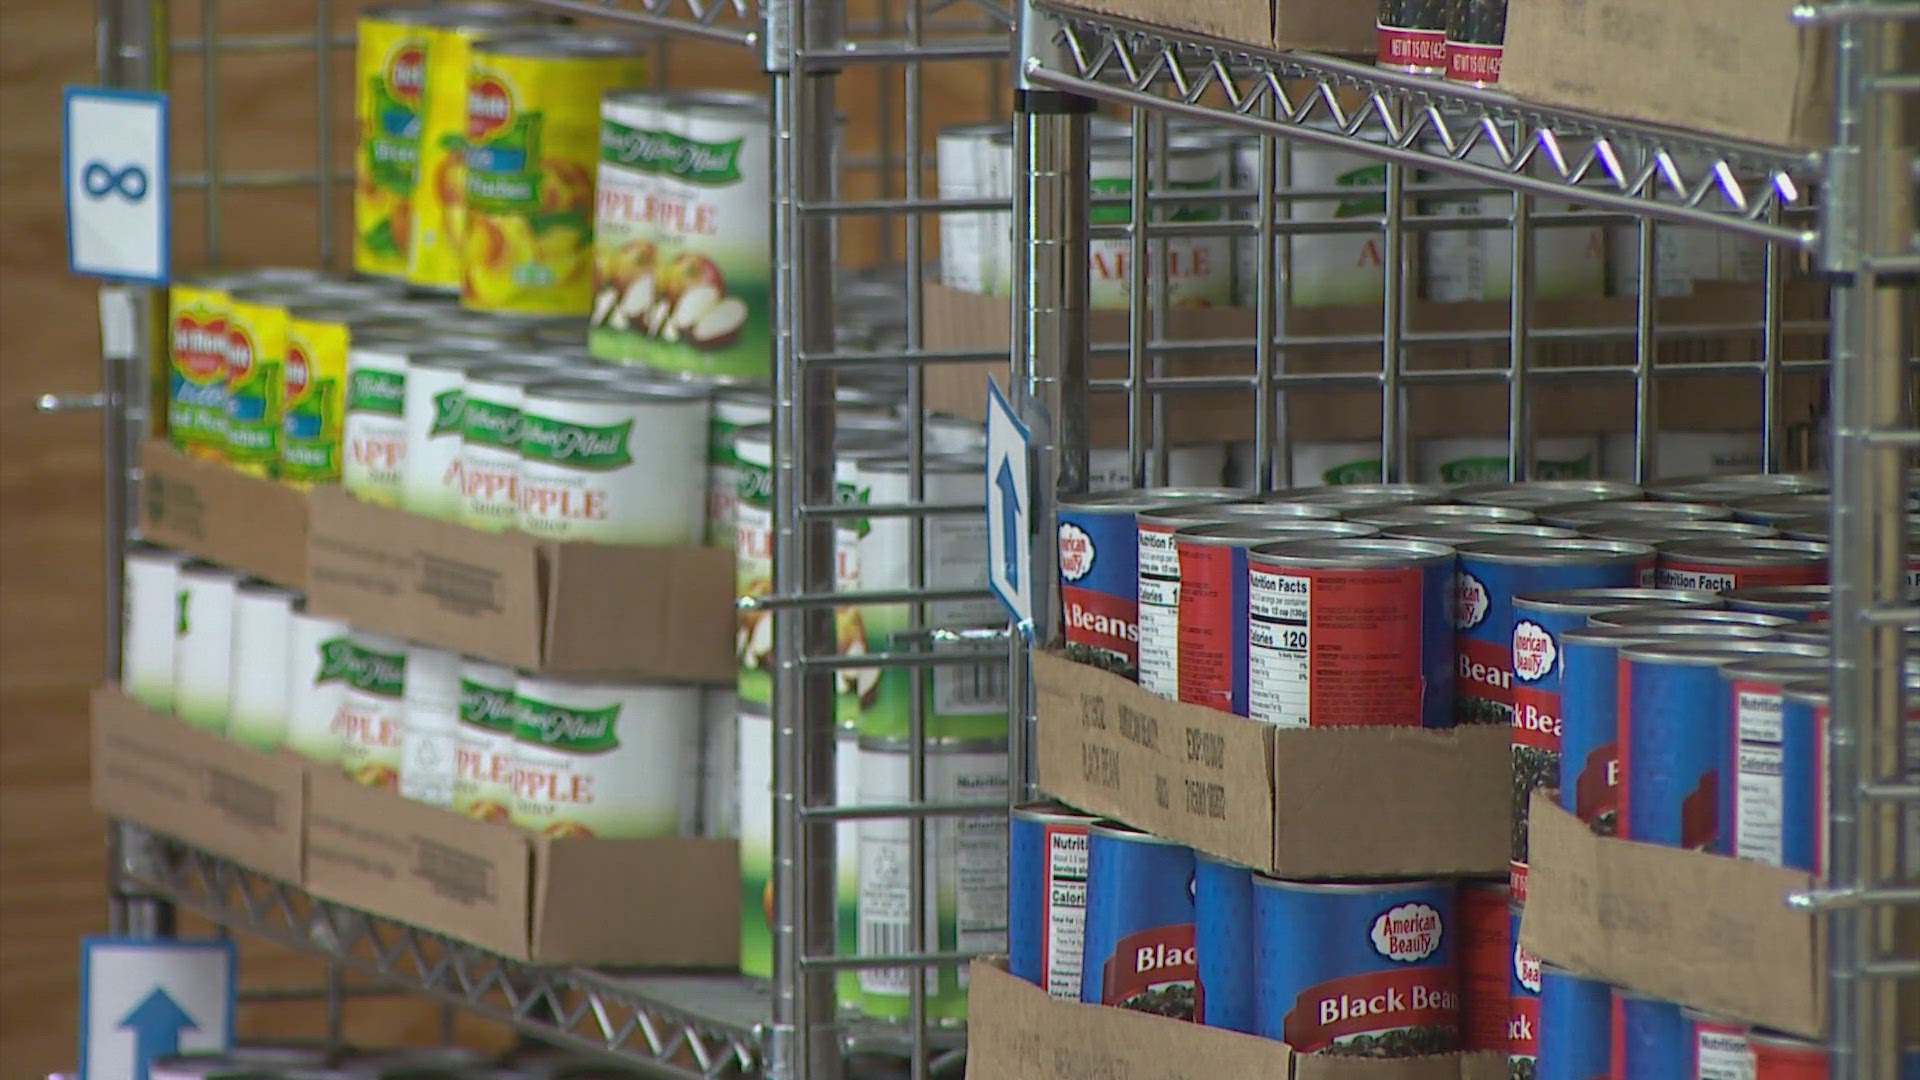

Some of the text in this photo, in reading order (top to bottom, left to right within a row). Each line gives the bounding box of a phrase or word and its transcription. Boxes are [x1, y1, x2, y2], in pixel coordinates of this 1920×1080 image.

[1090, 251, 1211, 281] APLE
[1279, 579, 1307, 593] Facts
[1699, 576, 1731, 591] Facts
[1283, 630, 1307, 648] 120
[1052, 890, 1085, 903] Calori
[1383, 913, 1436, 936] American
[1390, 933, 1431, 954] Beauty
[1319, 987, 1404, 1026] Black
